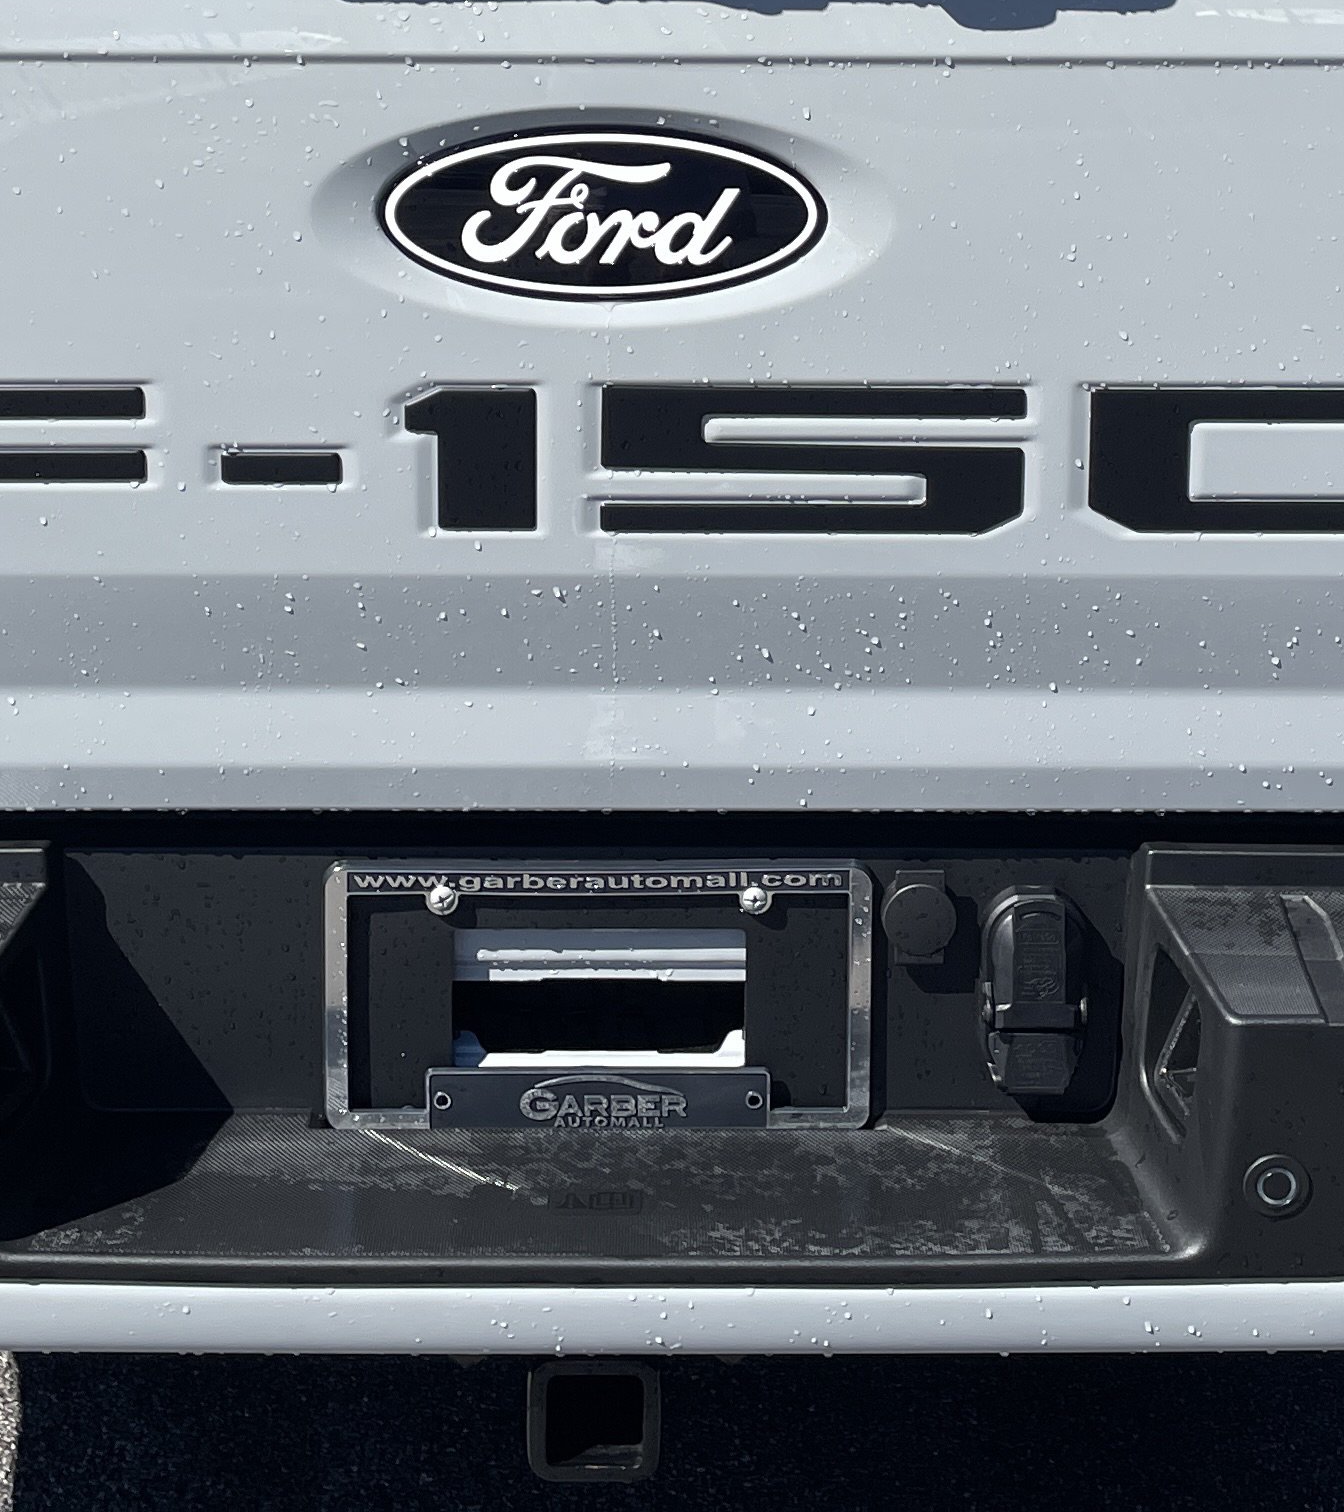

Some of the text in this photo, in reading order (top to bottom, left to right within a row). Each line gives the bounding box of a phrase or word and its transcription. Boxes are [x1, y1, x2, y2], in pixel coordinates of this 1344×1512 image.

[460, 155, 742, 267] Ford
[353, 870, 843, 893] www.garberautomall.com
[519, 1088, 688, 1122] GARBER
[553, 1115, 665, 1129] AUTOMALL
